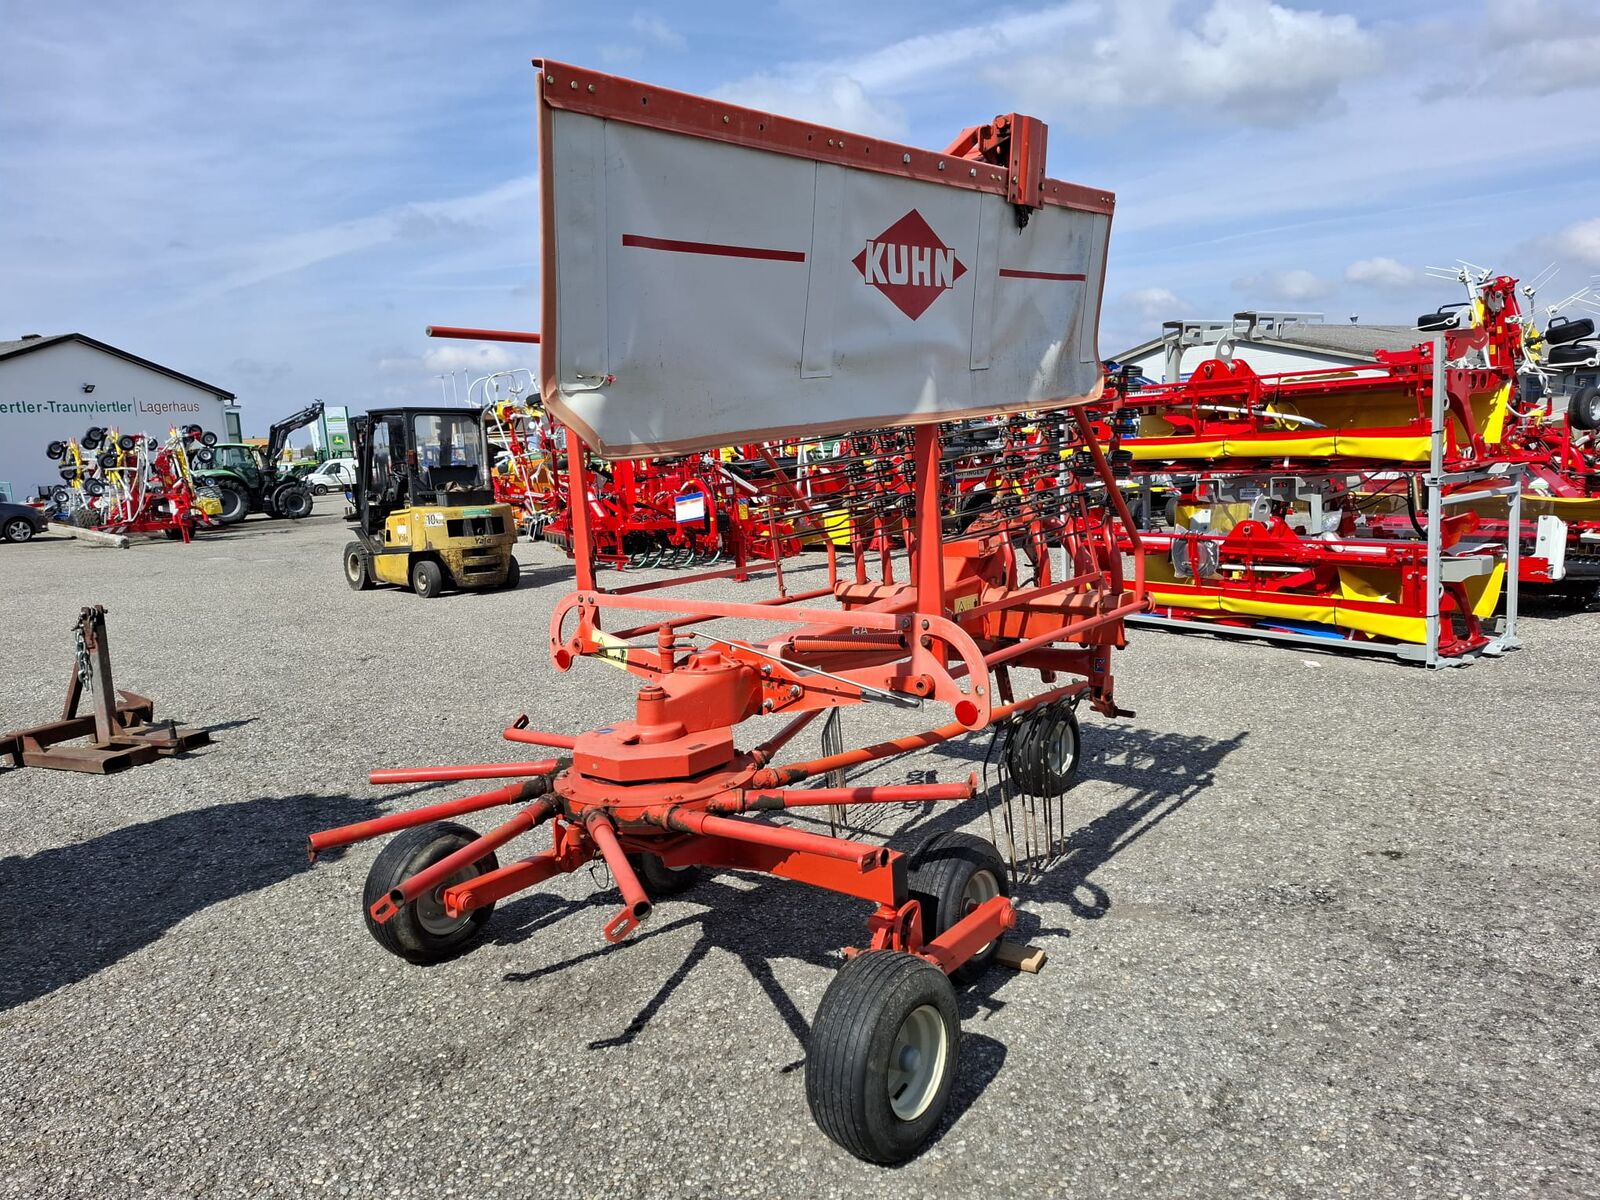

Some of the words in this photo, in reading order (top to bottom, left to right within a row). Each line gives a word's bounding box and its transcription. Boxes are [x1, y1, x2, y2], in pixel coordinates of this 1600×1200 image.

[865, 241, 955, 288] KUHN
[139, 401, 200, 415] Lagerhaus
[475, 536, 492, 544] Yale
